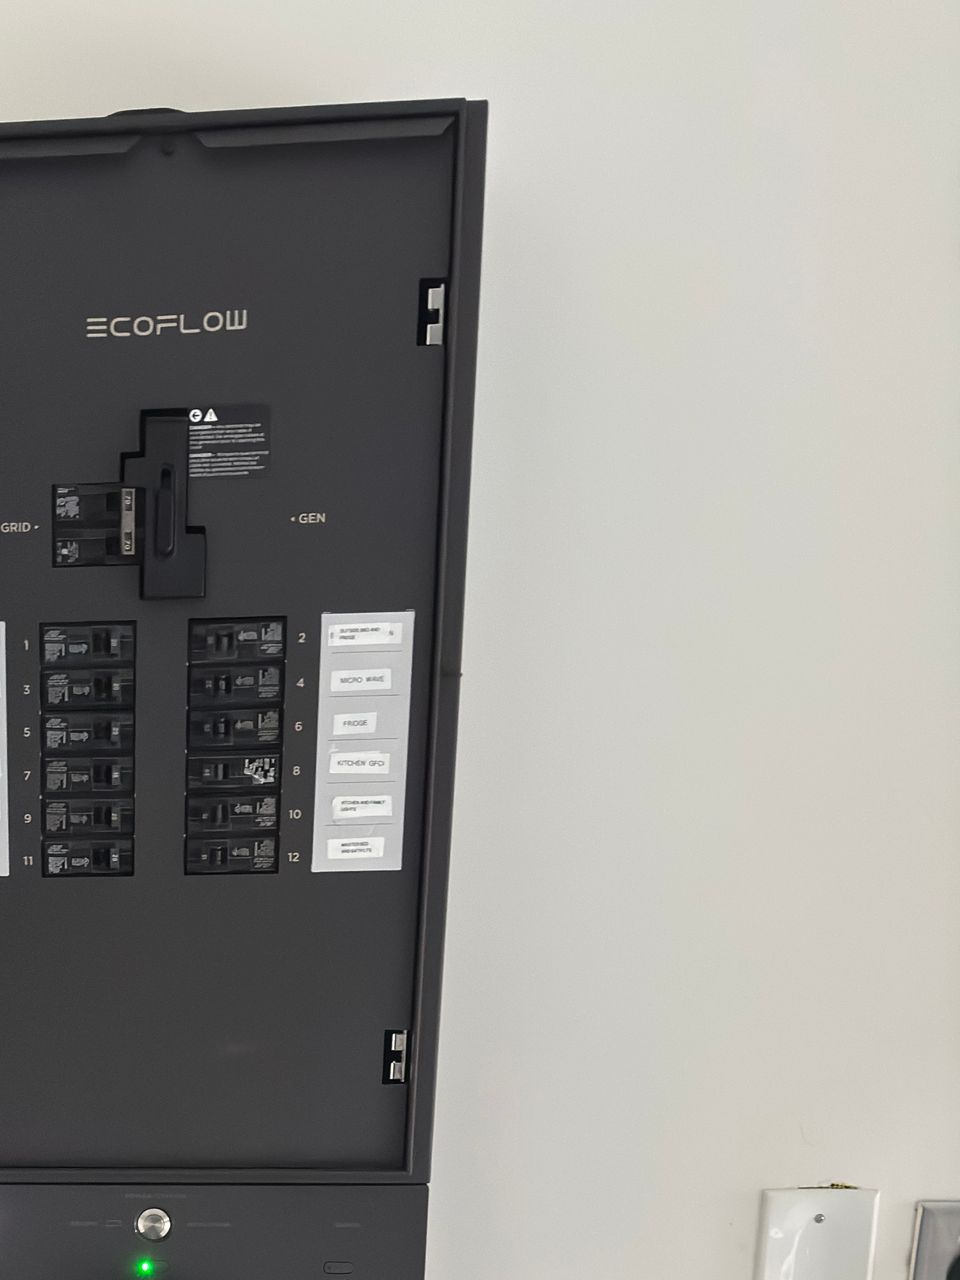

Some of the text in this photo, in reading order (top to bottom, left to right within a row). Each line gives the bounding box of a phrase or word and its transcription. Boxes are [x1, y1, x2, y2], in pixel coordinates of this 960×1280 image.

[86, 309, 248, 338] ECOFLOW
[299, 513, 326, 524] GEN
[0, 522, 31, 533] GRID
[298, 632, 306, 643] 2
[23, 639, 29, 651] 1
[296, 677, 305, 688] 4
[23, 684, 31, 695] 3
[294, 721, 303, 732] 6
[343, 719, 368, 727] FRIDGE
[23, 727, 31, 738] 5
[23, 770, 32, 781] 7
[292, 765, 301, 776] 8
[23, 813, 32, 824] 9
[288, 809, 302, 819] 10
[23, 855, 33, 866] 11
[287, 852, 300, 862] 12
